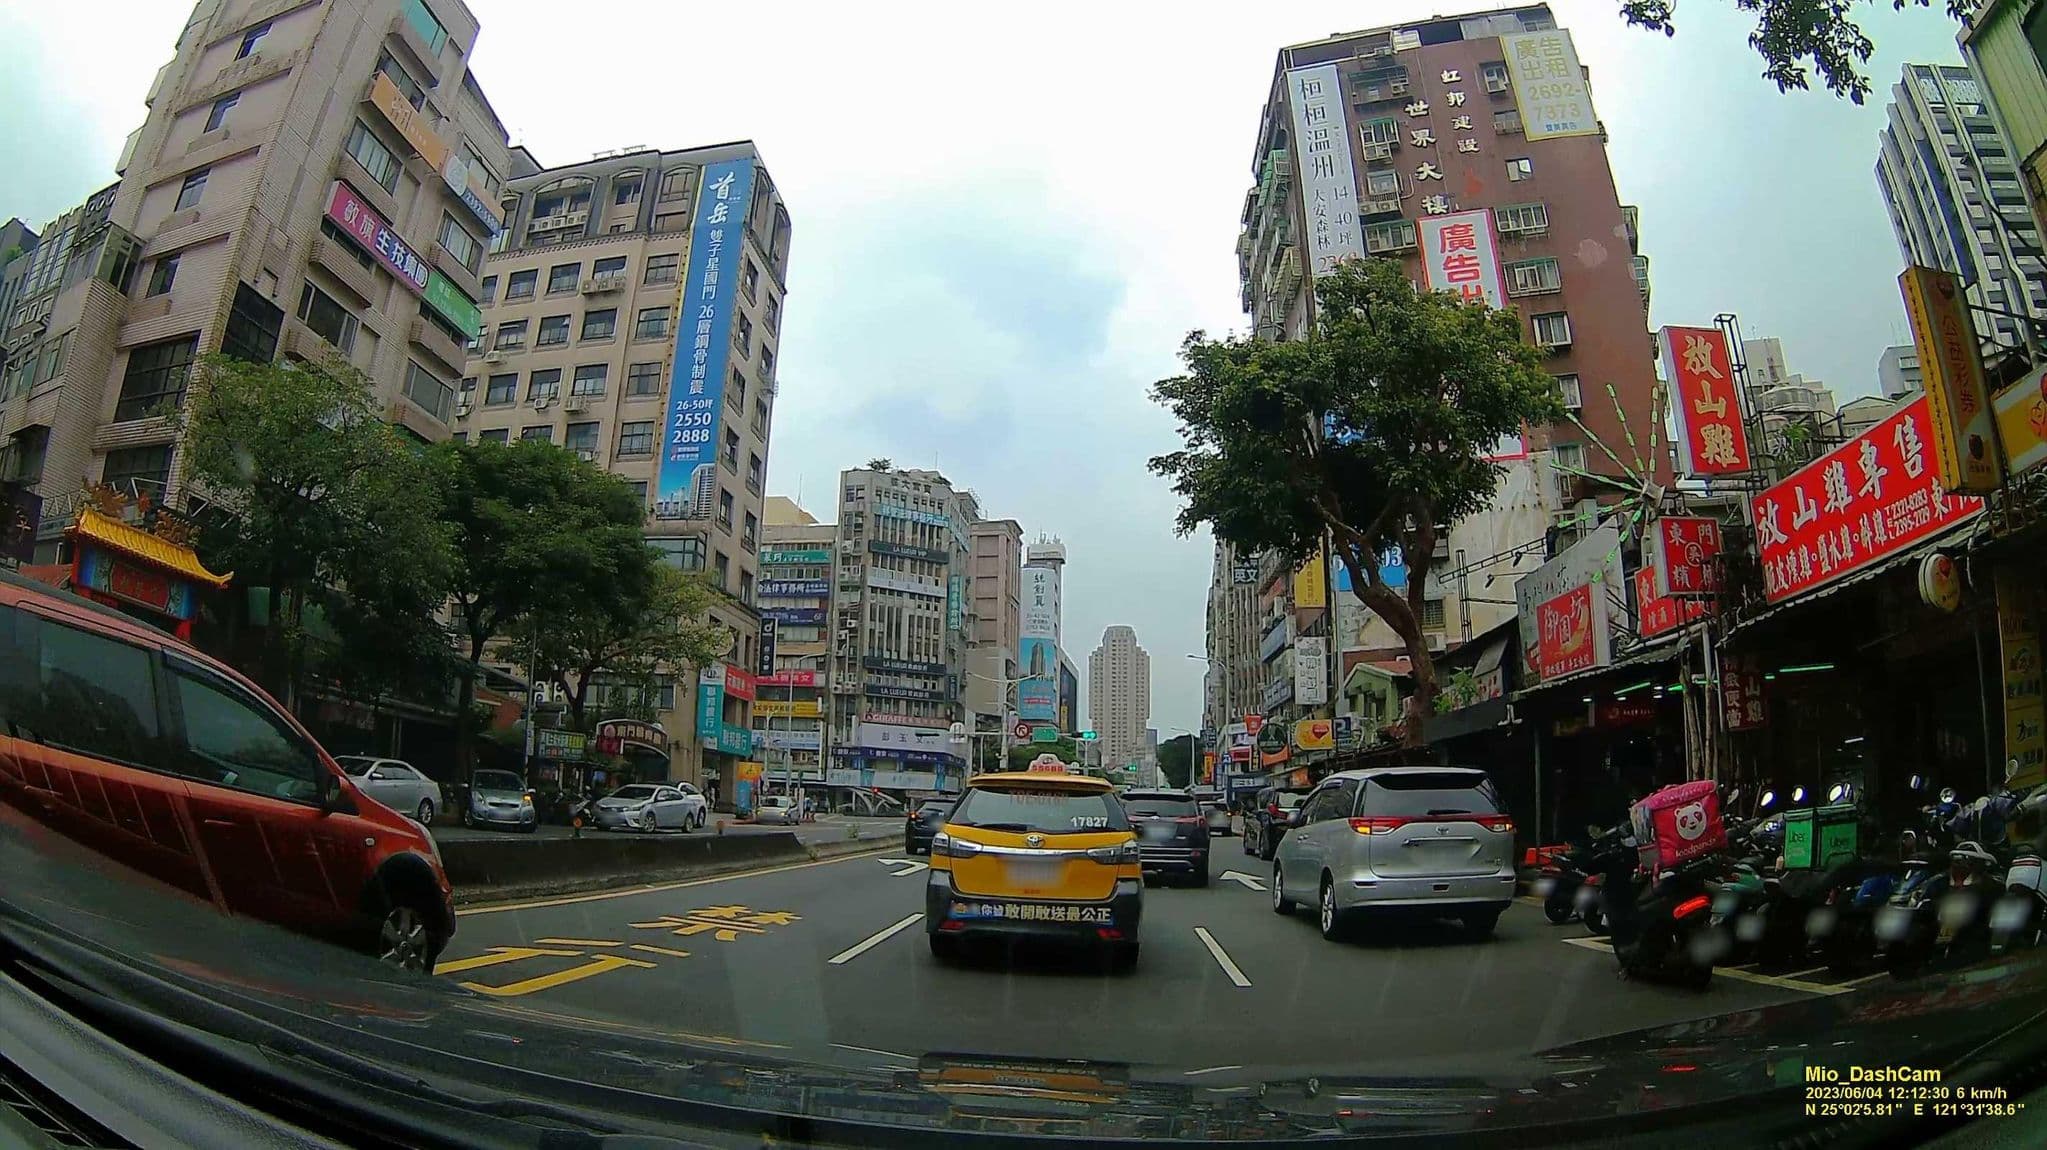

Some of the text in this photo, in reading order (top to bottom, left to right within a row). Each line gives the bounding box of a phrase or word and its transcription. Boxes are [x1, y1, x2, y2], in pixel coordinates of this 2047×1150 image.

[1520, 57, 1570, 80] 出租
[1404, 99, 1449, 216] 世界大樓
[1682, 334, 1741, 468] 放山雞
[674, 411, 712, 428] 2550
[672, 429, 710, 444] 2888
[1757, 413, 1924, 550] 放山雞專售
[1668, 521, 1715, 547] 東門
[1070, 816, 1108, 828] 17827
